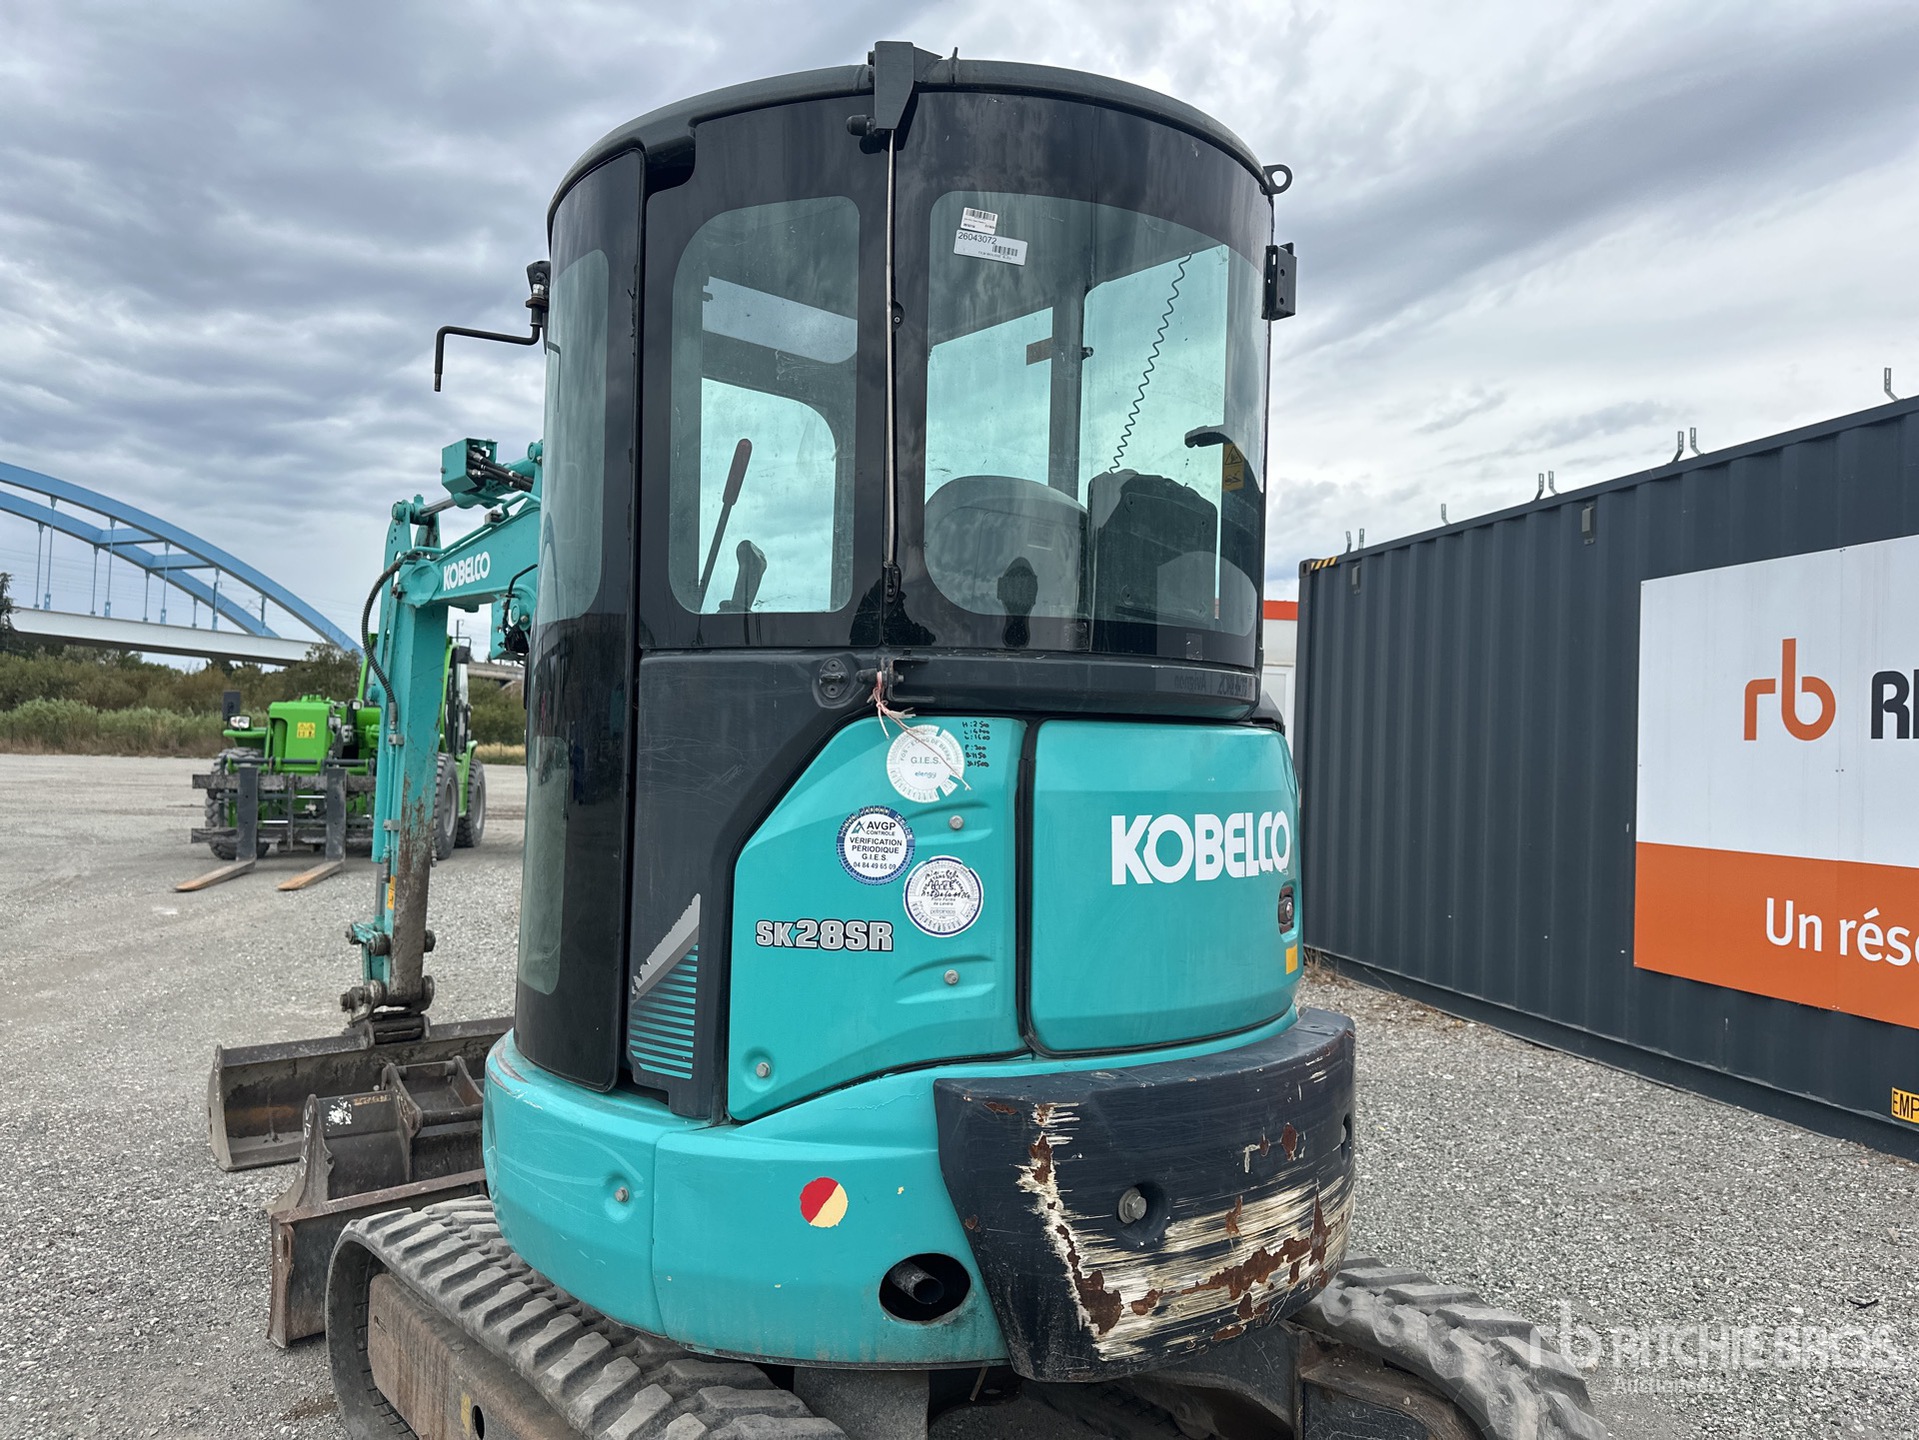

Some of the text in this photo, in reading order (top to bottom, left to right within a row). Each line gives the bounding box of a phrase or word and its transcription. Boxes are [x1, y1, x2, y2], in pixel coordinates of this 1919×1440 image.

[958, 231, 997, 245] 26043072
[443, 551, 491, 591] KOBELCO
[1744, 637, 1836, 741] rb
[910, 756, 941, 764] G.I.E.S.
[914, 770, 937, 779] elengy
[866, 821, 896, 830] AVGP
[849, 836, 903, 846] VÉRIFICATION
[1111, 810, 1290, 885] KOBELCO
[755, 917, 894, 952] SK28SR
[1766, 897, 1919, 966] Un rés
